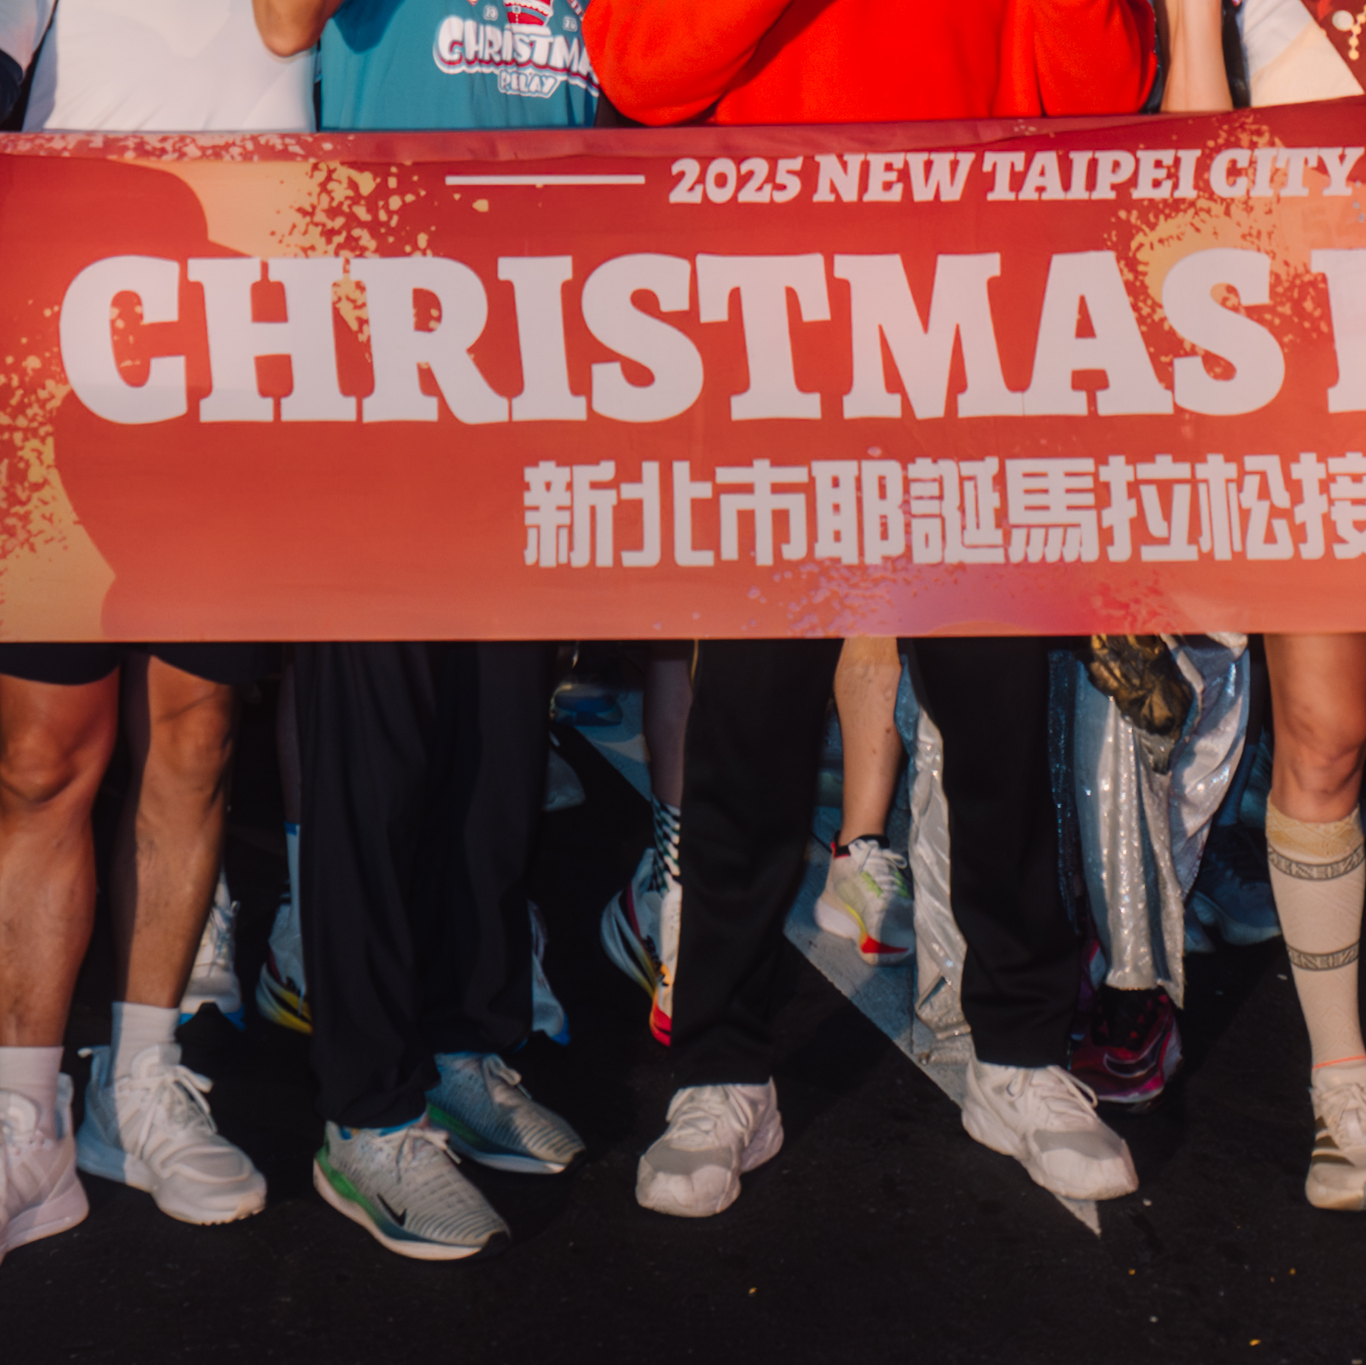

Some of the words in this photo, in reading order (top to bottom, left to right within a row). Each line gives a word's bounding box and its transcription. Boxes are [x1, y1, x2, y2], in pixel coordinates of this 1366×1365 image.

[438, 15, 597, 78] CHRISTMA
[668, 156, 803, 203] 2025
[813, 152, 976, 203] NEW
[982, 148, 1202, 202] TAIPEI
[1209, 145, 1366, 199] CITY
[59, 247, 1285, 424] CHRISTMAS
